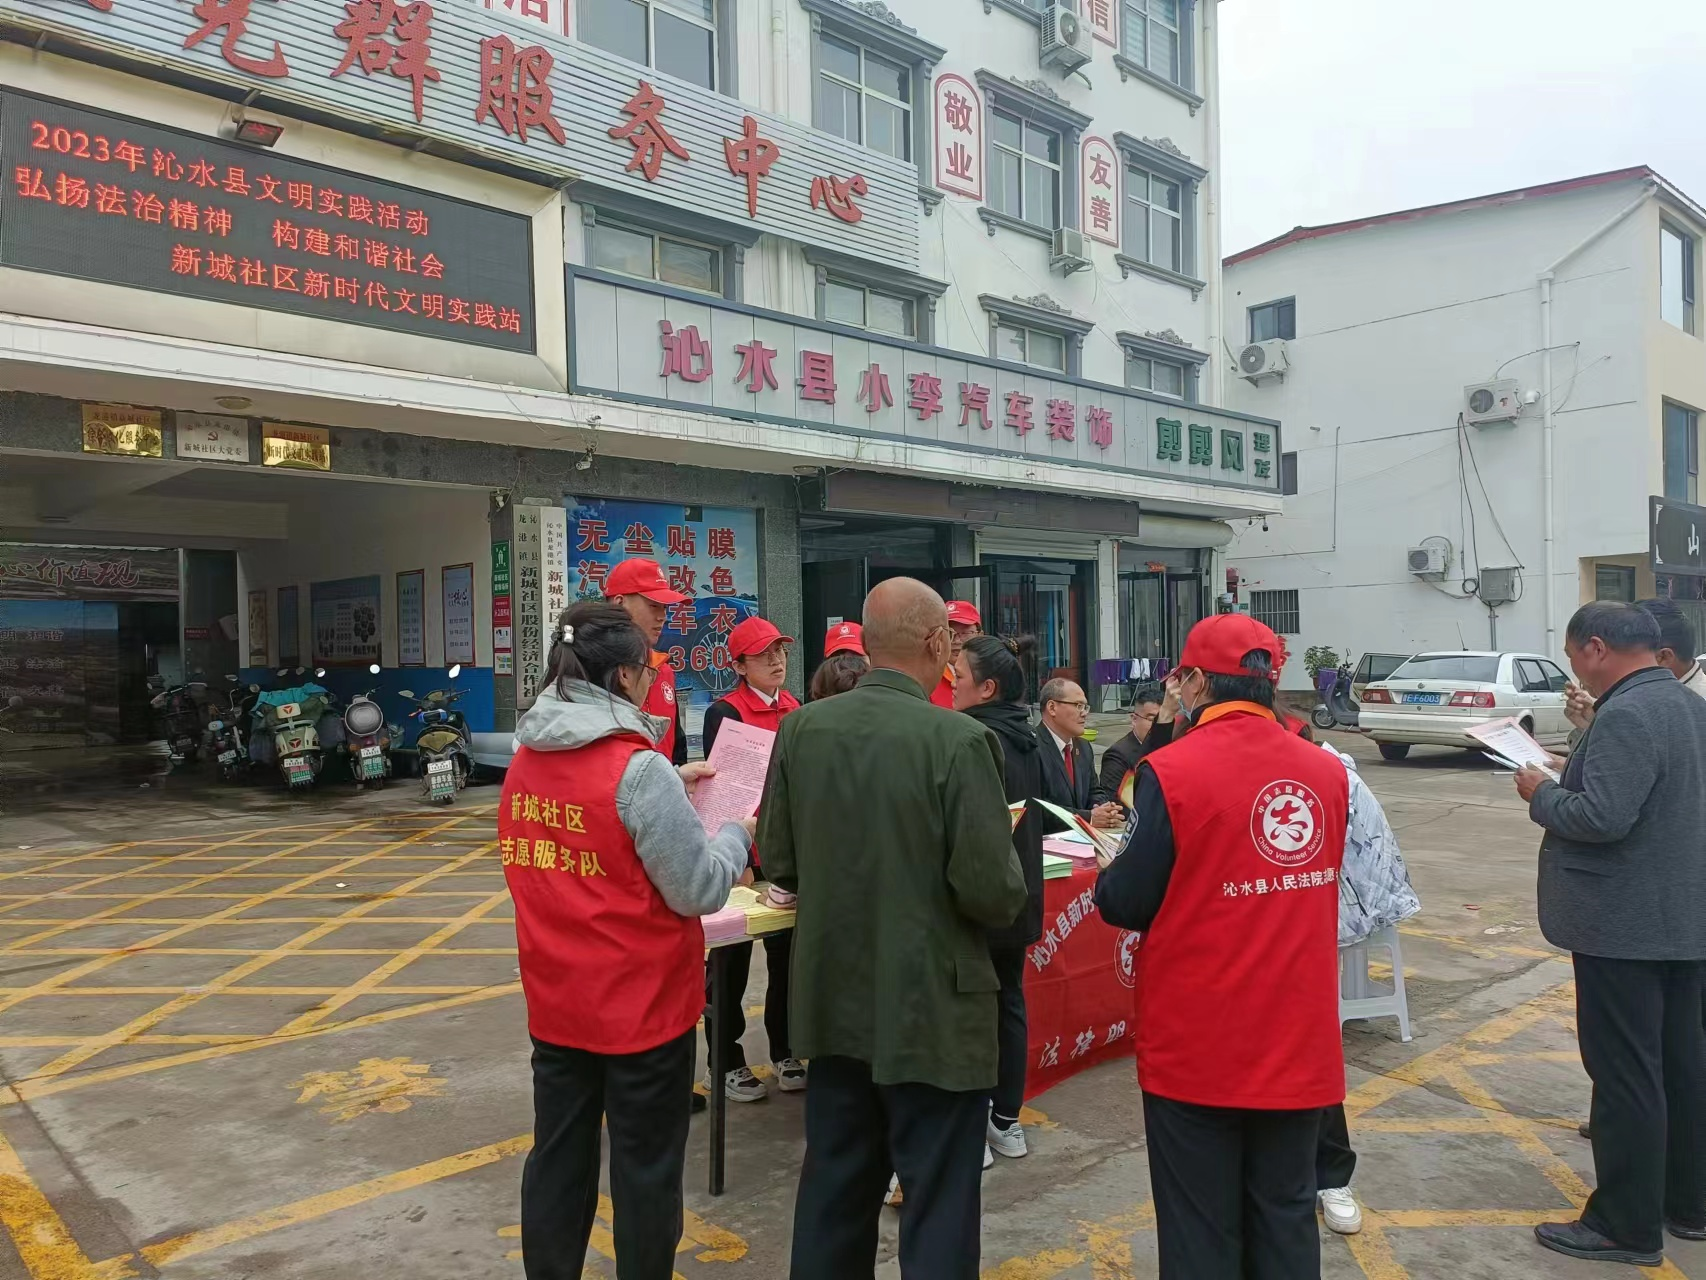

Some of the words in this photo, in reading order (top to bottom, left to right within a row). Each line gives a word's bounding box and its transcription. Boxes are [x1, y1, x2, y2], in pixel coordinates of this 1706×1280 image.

[94, 0, 868, 224] 党群服务中心
[943, 90, 973, 184] 敬业
[31, 120, 430, 237] 2023年沁水县文明实践活动
[1089, 153, 1112, 233] 友善
[15, 165, 234, 238] 弘扬法治精神
[271, 218, 446, 281] 构建和谐社会
[170, 243, 523, 336] 新城社区新时代文明实践站
[659, 319, 1114, 450] 沁水县小李汽车装饰
[577, 519, 737, 560] 无尘贴膜
[577, 560, 737, 598] 汽改色
[519, 565, 539, 698] 新城社区股份经济合作社
[668, 603, 737, 636] 车衣
[668, 645, 729, 671] 360
[511, 792, 587, 833] 新城社区
[1257, 836, 1274, 856] China
[1275, 850, 1308, 862] Volunteer
[1307, 828, 1322, 853] Service
[501, 836, 607, 877] 志愿服务队
[1027, 882, 1096, 973] 沁水县新时
[1038, 1019, 1136, 1069] 法律明
